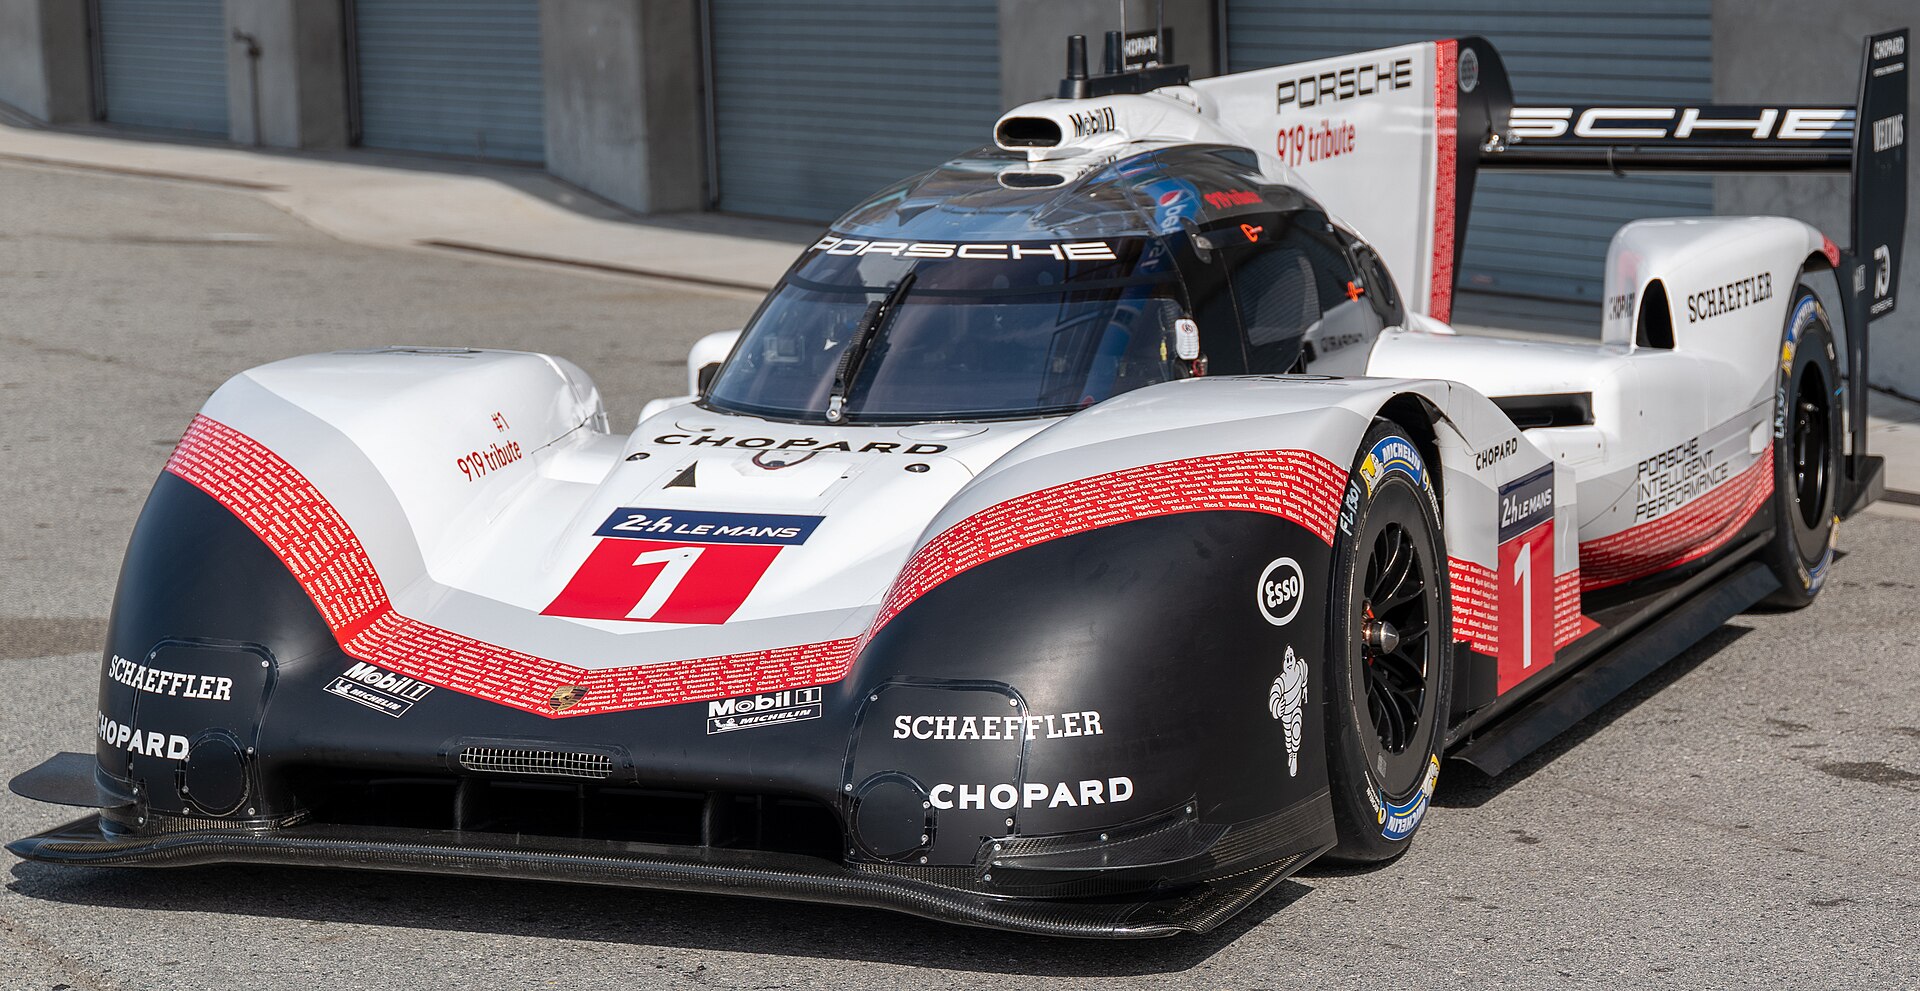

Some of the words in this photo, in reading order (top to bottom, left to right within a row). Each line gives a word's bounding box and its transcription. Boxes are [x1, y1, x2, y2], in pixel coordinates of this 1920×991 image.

[1277, 58, 1411, 114] PORSCHE
[1277, 123, 1305, 168] 919
[1308, 119, 1355, 162] tribute
[808, 235, 1117, 260] PORSCHE
[1688, 271, 1773, 323] SCHAEFFLER
[491, 411, 510, 432] #1
[457, 451, 486, 482] 919
[482, 440, 522, 471] tribute
[653, 434, 948, 454] CHOPARD
[1382, 443, 1420, 471] MICHELIN
[1475, 437, 1518, 471] CHOPARD
[1637, 437, 1698, 480] PORSCHE
[1634, 461, 1729, 523] PERFORMANCE
[1637, 449, 1713, 502] INTELLIGENT
[1518, 500, 1528, 520] LE
[1529, 488, 1552, 515] MANS
[673, 523, 716, 536] LE
[712, 526, 802, 539] MANS
[624, 546, 707, 619] 1
[1514, 542, 1532, 669] 1
[108, 654, 233, 701] SCHAEFFLER
[342, 661, 415, 694] Mobil
[349, 689, 402, 710] MICHELIN
[708, 690, 791, 717] Mobil
[739, 709, 812, 725] MICHELIN
[893, 711, 1104, 740] SCHAEFFLER
[929, 776, 1134, 810] CHOPARD
